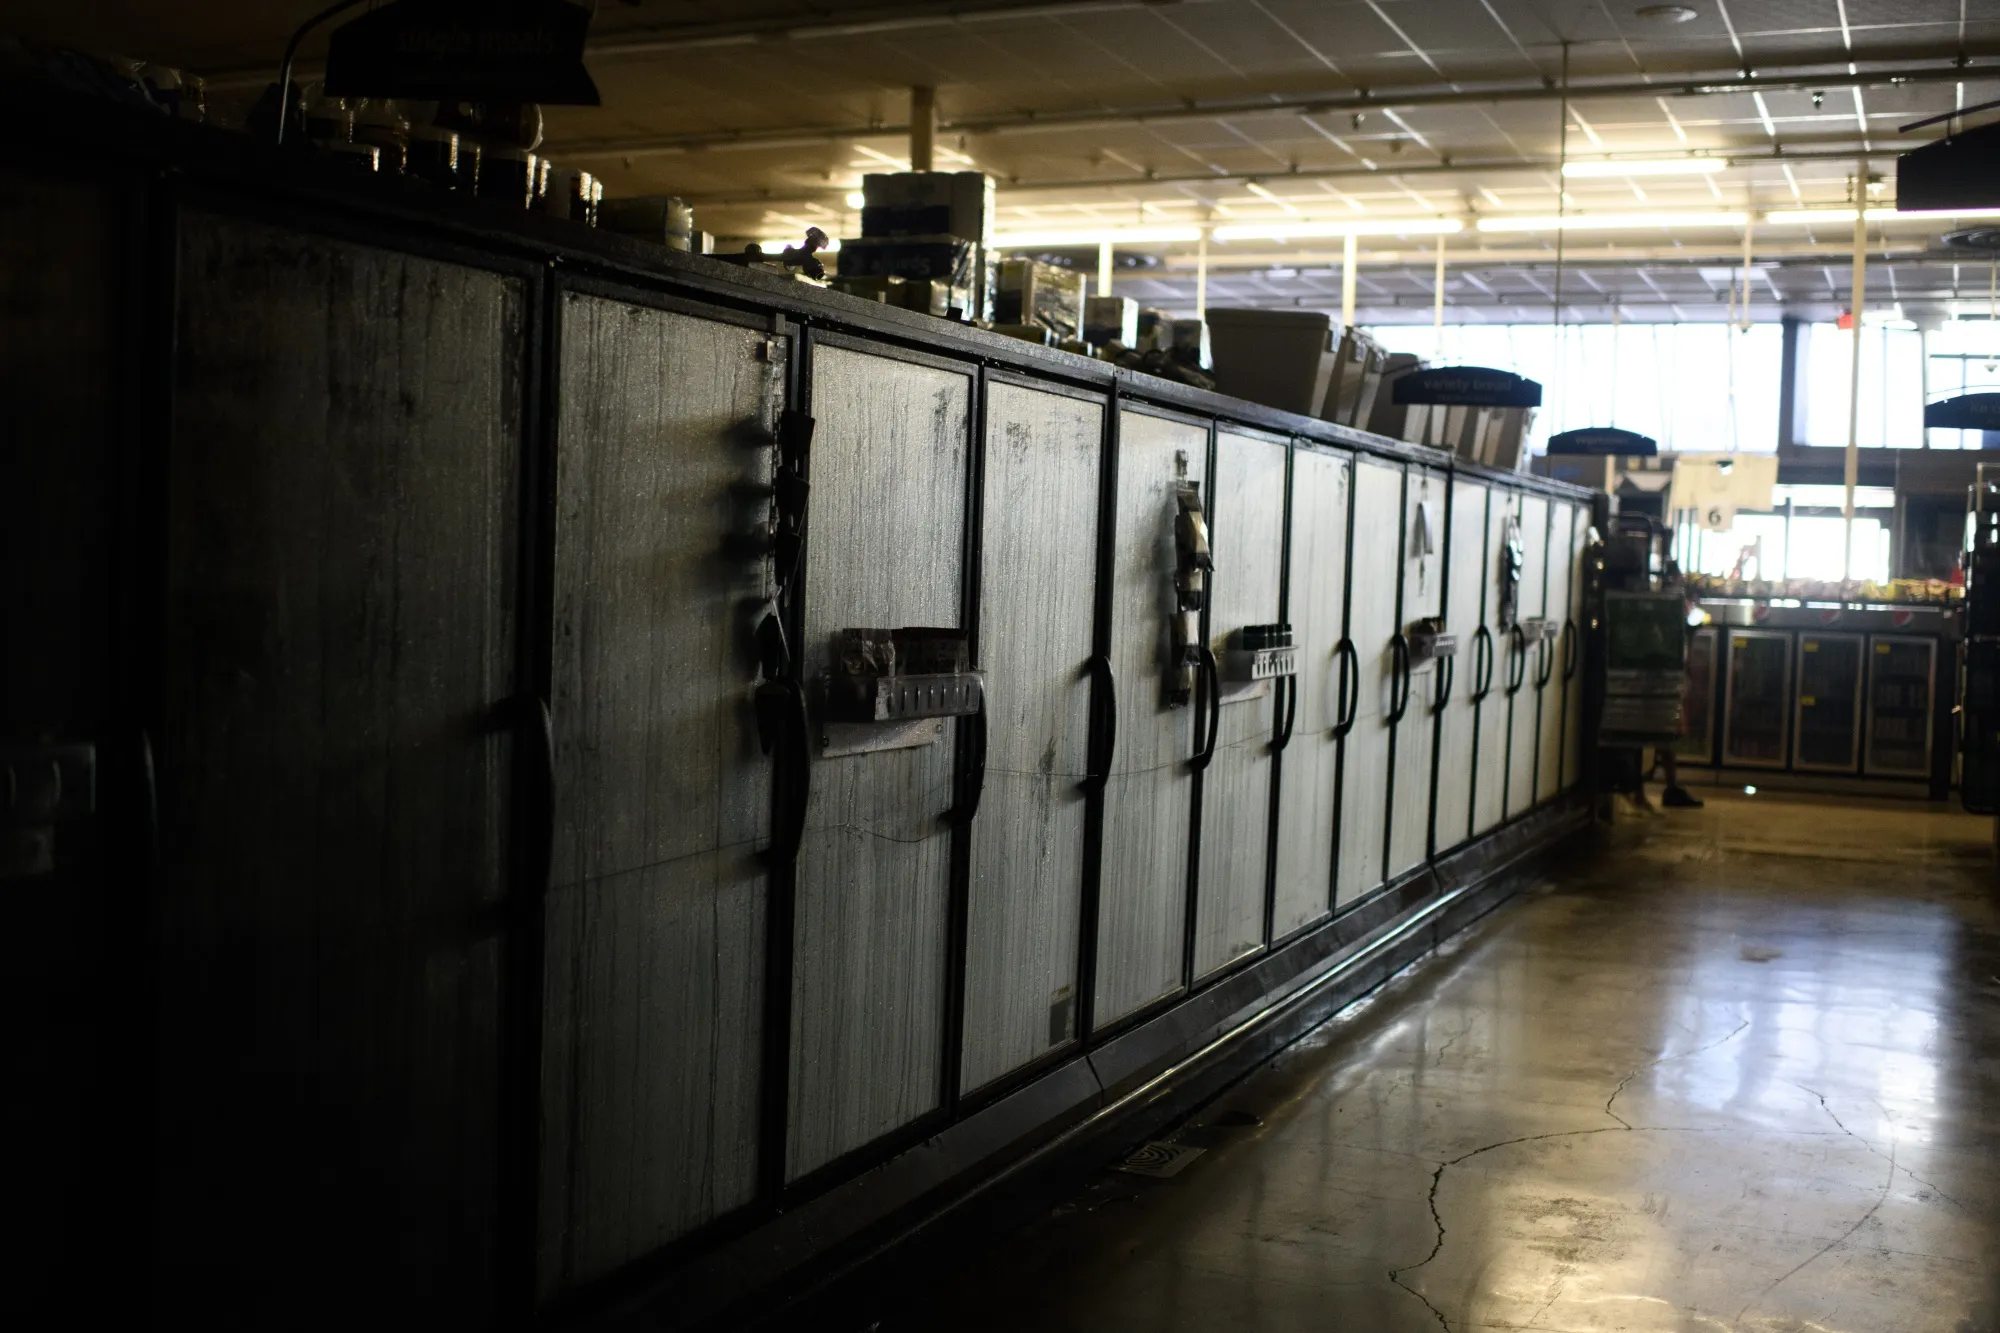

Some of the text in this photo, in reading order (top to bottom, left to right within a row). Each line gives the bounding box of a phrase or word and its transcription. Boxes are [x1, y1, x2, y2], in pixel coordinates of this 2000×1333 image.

[1423, 378, 1512, 393] variety bread
[1708, 506, 1721, 526] 6
